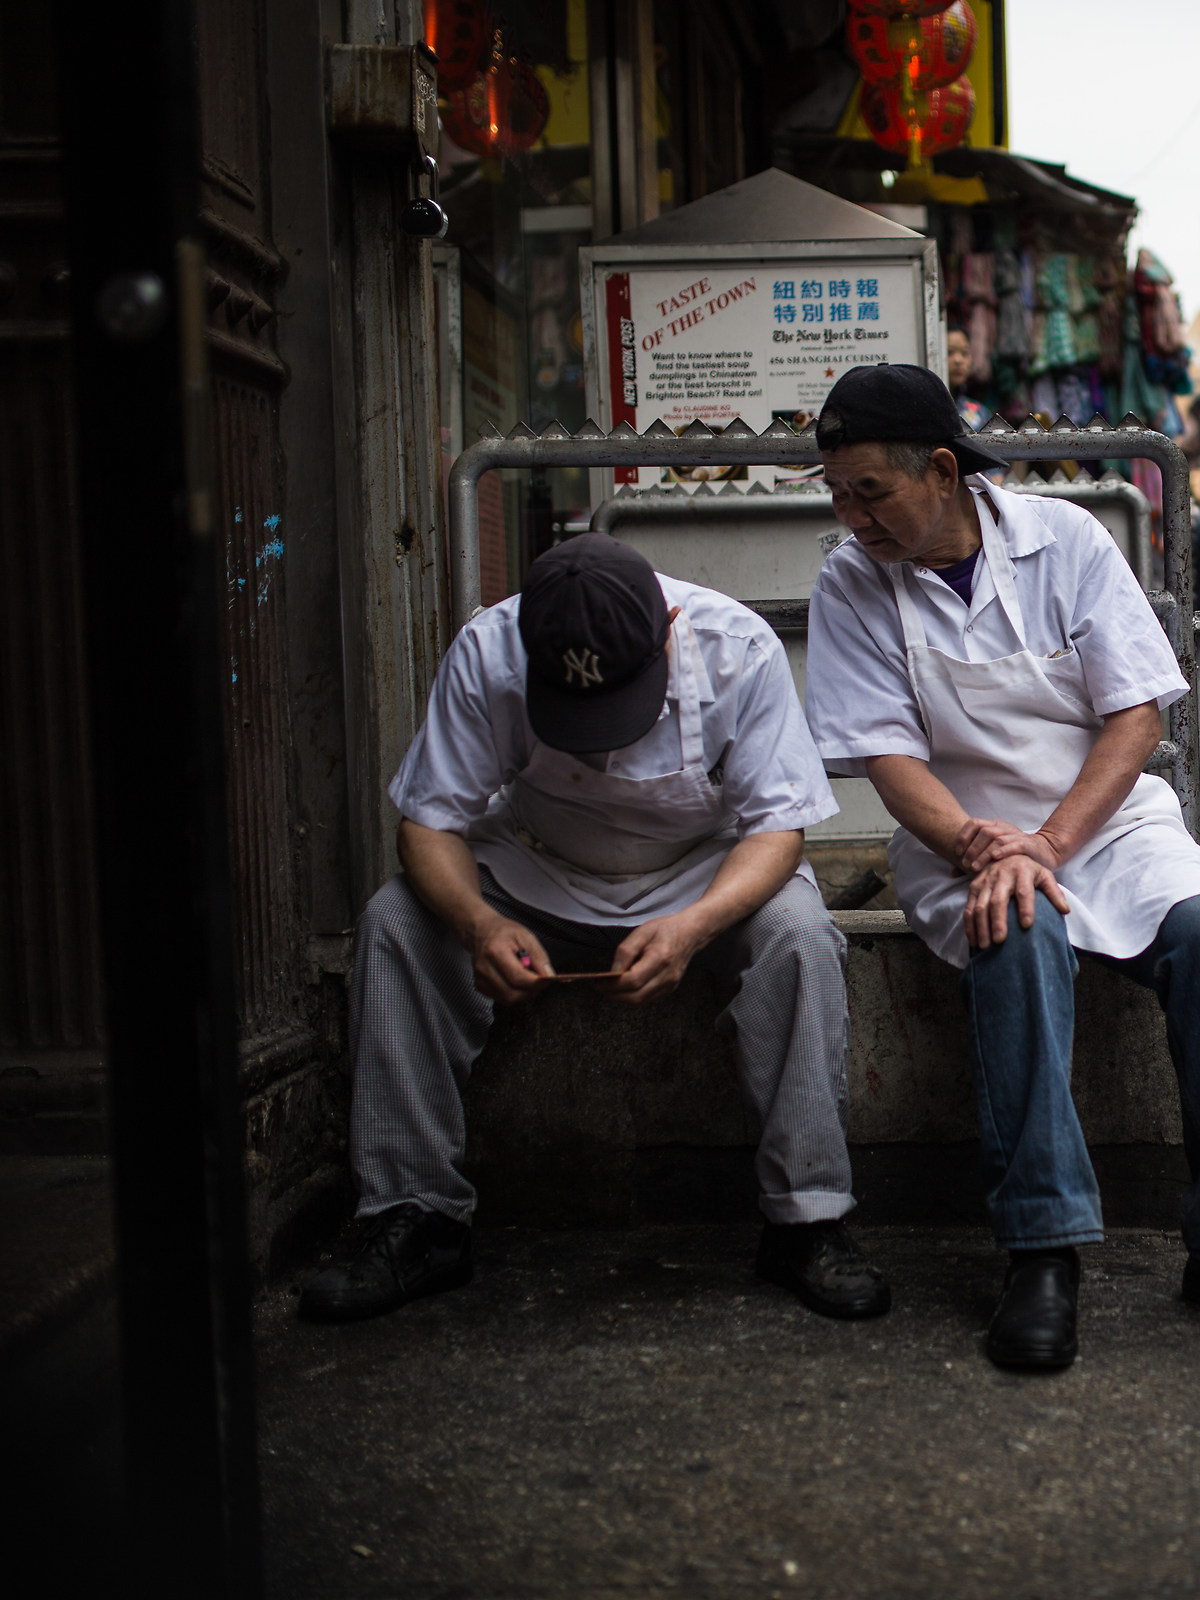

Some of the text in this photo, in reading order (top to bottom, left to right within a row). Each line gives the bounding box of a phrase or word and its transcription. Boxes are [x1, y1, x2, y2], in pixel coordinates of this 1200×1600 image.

[656, 276, 712, 317] TASTE
[773, 278, 879, 300] 紐約時報
[641, 276, 757, 352] OF THE TOWN
[774, 302, 880, 323] 特別推薦
[620, 315, 635, 348] POST
[772, 327, 889, 344] The New York Times
[621, 347, 637, 379] YORK
[652, 352, 675, 361] Want
[677, 352, 686, 360] to
[688, 351, 713, 360] know
[715, 351, 742, 359] where
[656, 361, 750, 371] find the tastiest soup
[769, 353, 889, 365] 456 SHANGHAI CUISINE
[649, 372, 697, 382] dumplings
[709, 370, 757, 379] Chinatown
[668, 381, 682, 389] the
[684, 381, 704, 389] best
[706, 380, 741, 388] borscht
[623, 378, 638, 407] NEW
[645, 391, 685, 401] Brighton
[687, 390, 720, 399] Beach?
[723, 389, 746, 397] Read
[562, 647, 604, 688] NY
